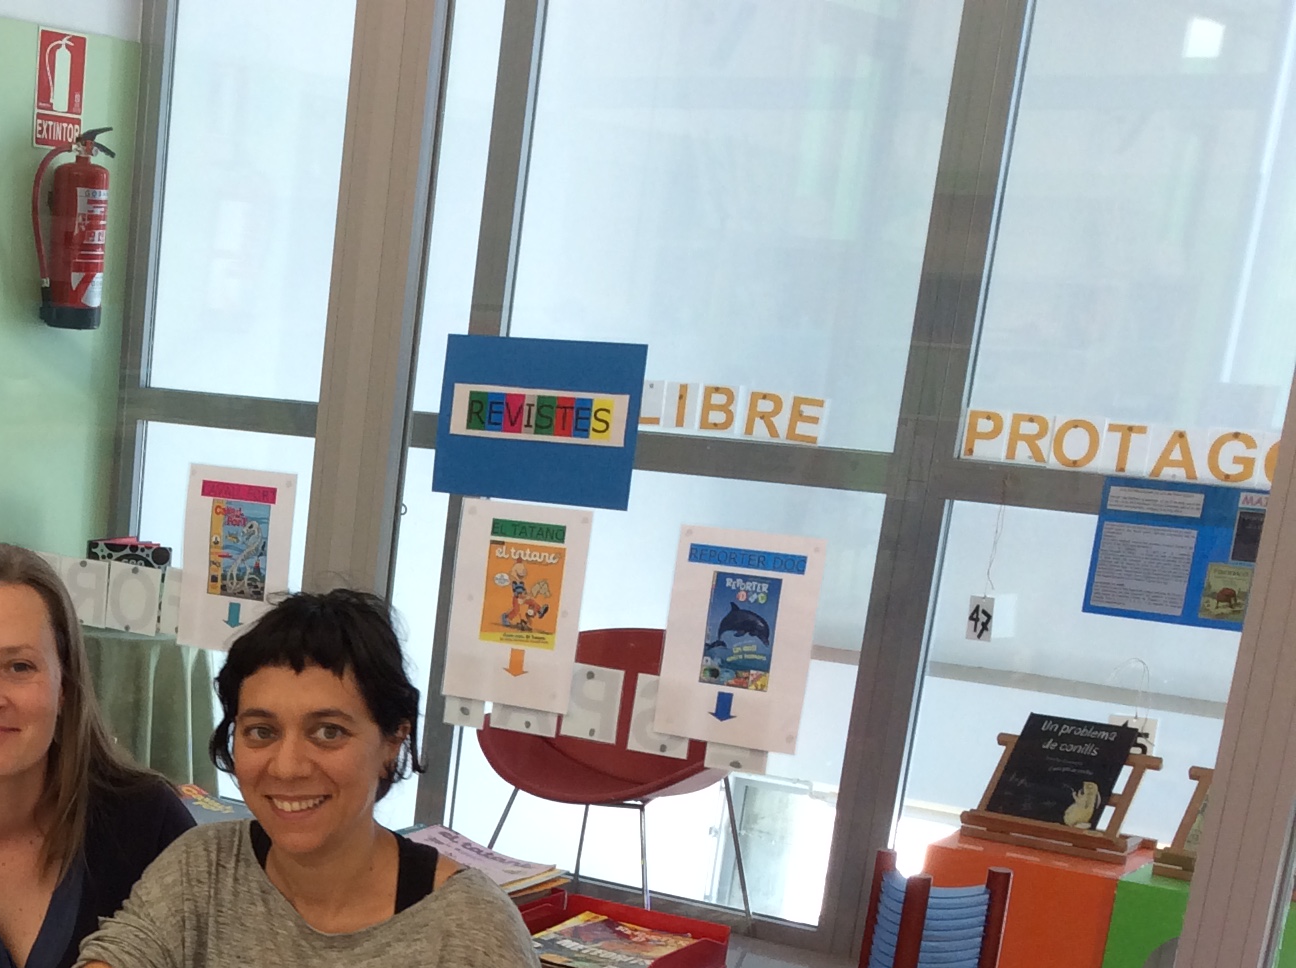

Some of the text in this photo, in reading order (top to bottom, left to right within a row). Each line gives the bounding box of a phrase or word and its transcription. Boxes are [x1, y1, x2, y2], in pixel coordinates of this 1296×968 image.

[36, 119, 80, 143] EXTINTOR
[468, 399, 611, 434] REVISTES
[492, 522, 565, 541] EL TATANO
[689, 547, 807, 572] REPORTER DOC
[968, 604, 993, 640] 47
[1041, 720, 1118, 741] Un problema
[1042, 738, 1100, 757] de conills
